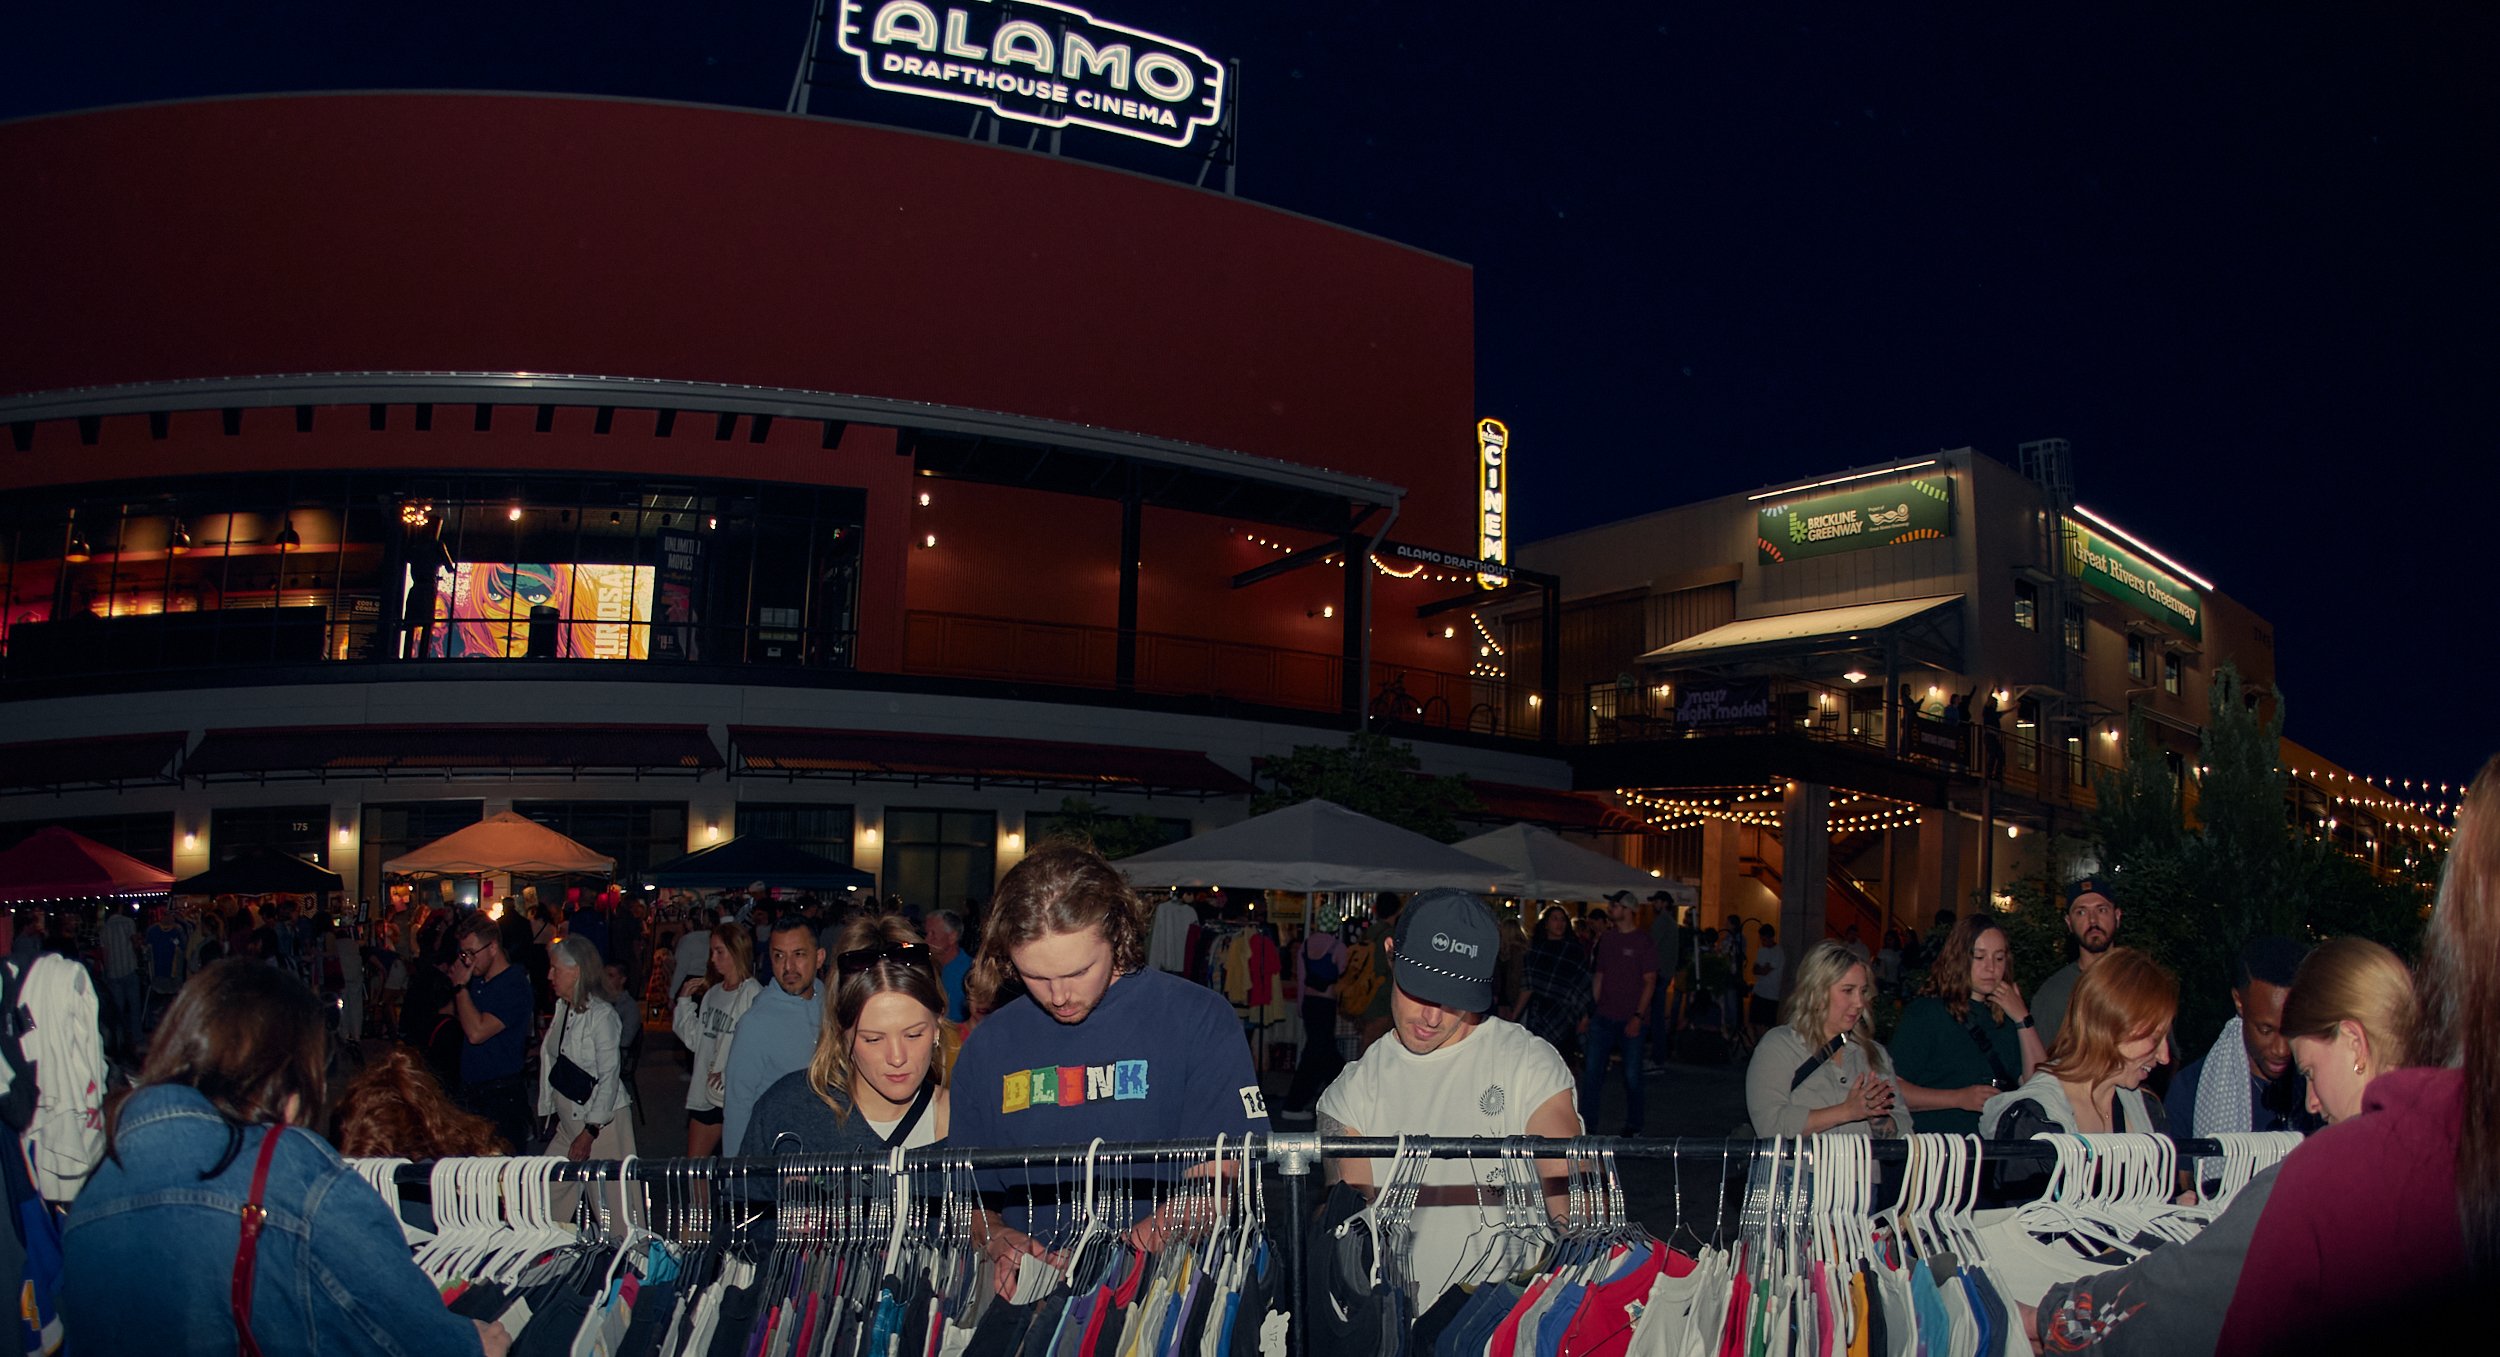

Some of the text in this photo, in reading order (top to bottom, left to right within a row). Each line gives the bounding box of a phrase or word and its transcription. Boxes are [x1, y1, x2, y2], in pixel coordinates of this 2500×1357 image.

[872, 0, 1194, 102] ALAMO
[882, 53, 1178, 129] DRAFTHOUSE CINEMA
[1807, 509, 1857, 530] BRICKLINE
[1807, 521, 1863, 542] GREENWAY
[1397, 545, 1440, 563] ALAMO
[2073, 540, 2197, 626] Great Rivers Greenway
[1715, 699, 1768, 720] market
[292, 822, 309, 831] 175
[1449, 938, 1479, 959] janji
[1002, 1059, 1149, 1114] BLINK
